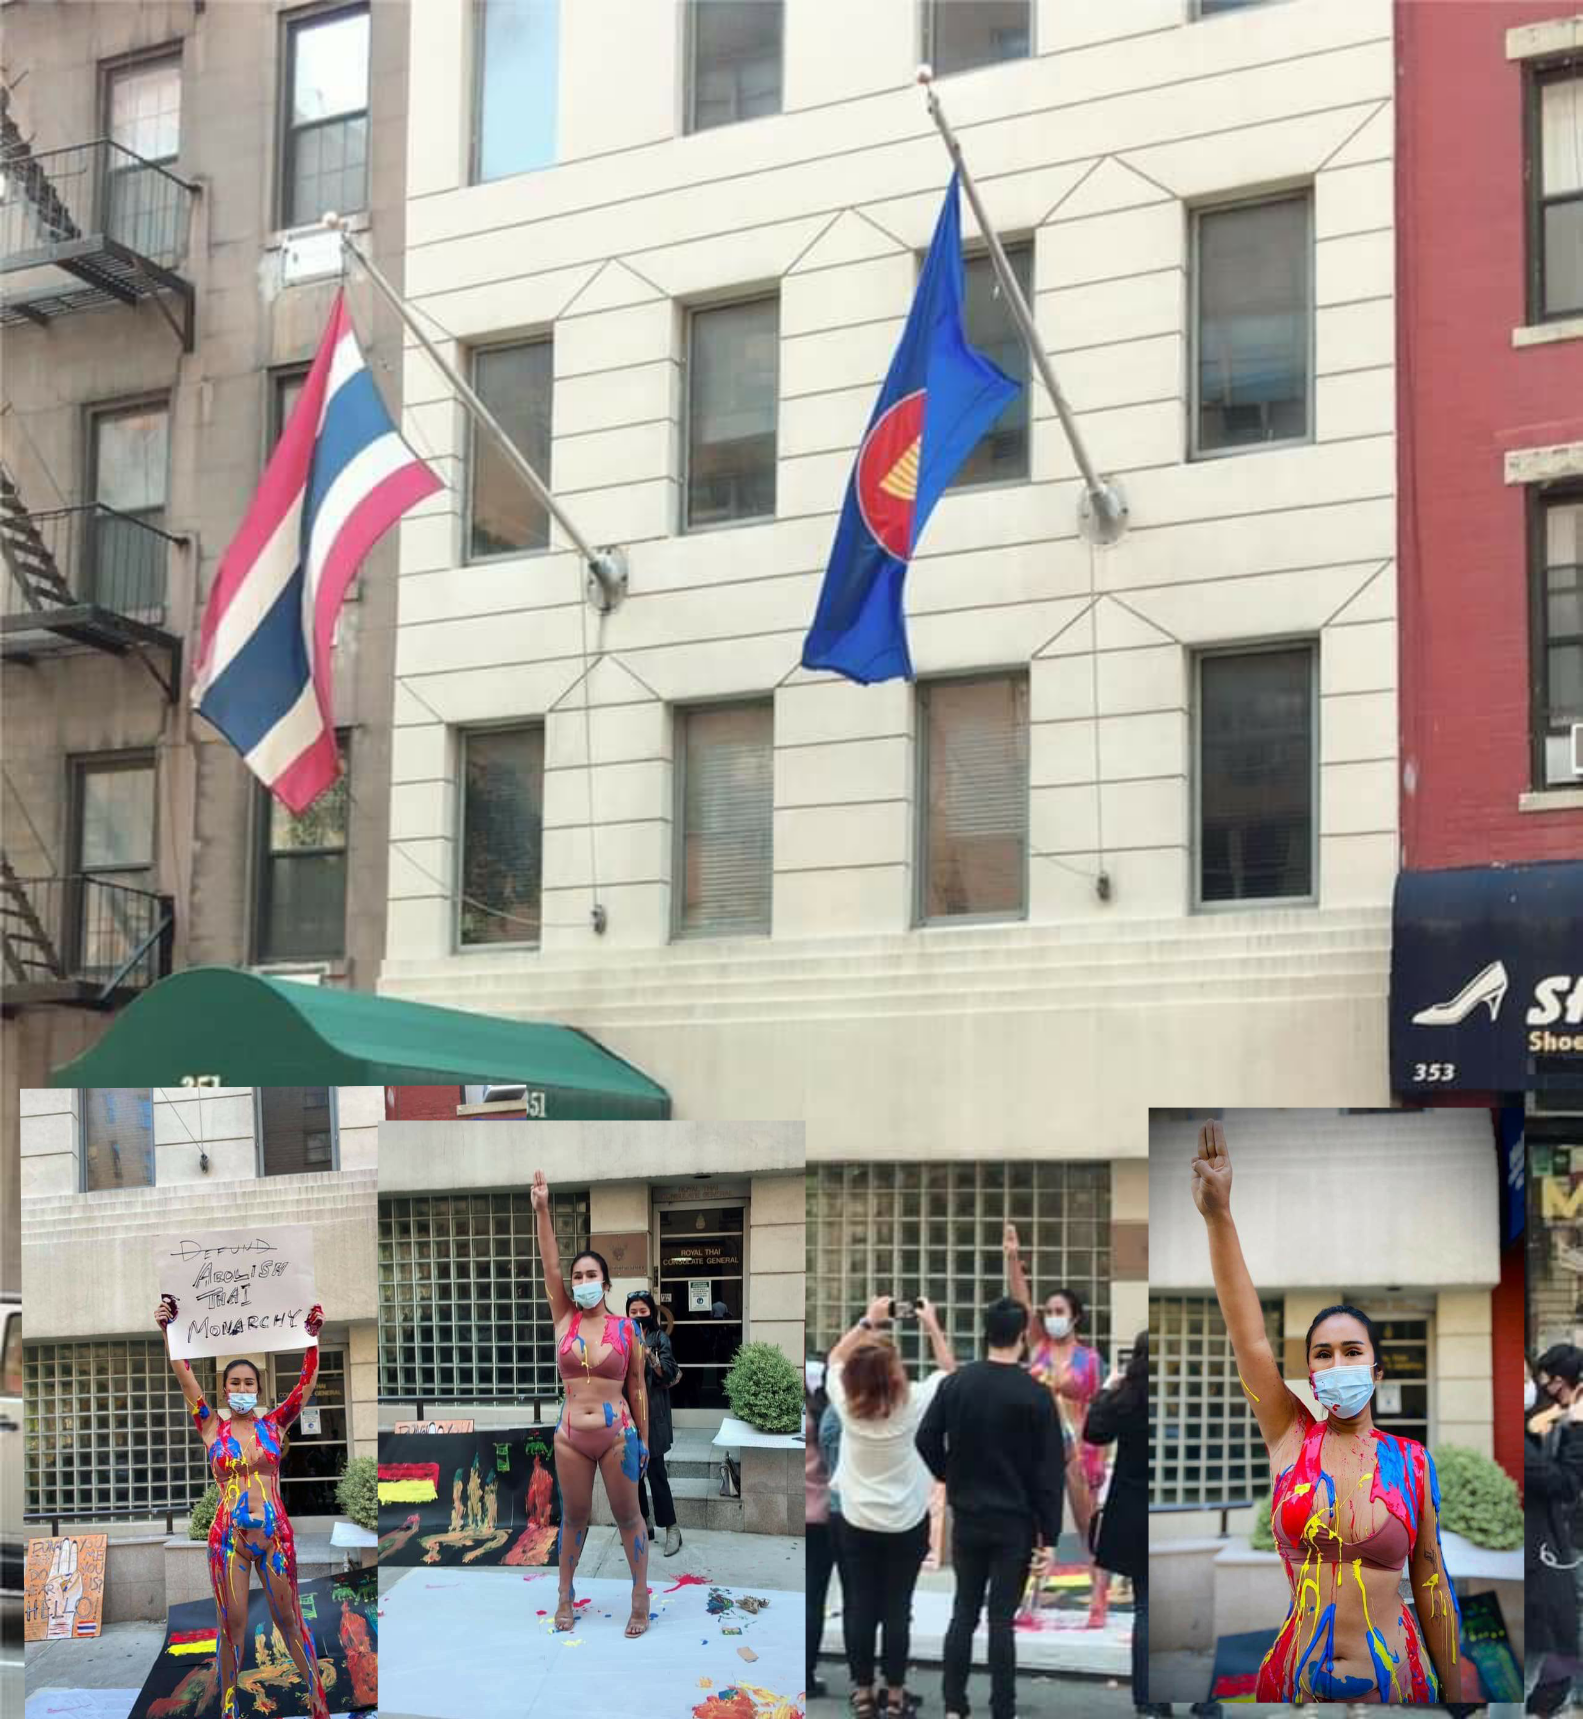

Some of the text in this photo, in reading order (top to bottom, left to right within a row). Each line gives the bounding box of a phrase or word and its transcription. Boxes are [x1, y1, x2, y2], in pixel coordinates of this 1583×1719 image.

[1412, 1063, 1455, 1081] 353
[526, 1091, 546, 1118] 51
[706, 1256, 738, 1264] GENERAL
[193, 1260, 289, 1288] ABOLISH
[196, 1284, 251, 1309] THAI
[188, 1309, 302, 1343] MONARCHY
[25, 1597, 99, 1621] HELLO!
